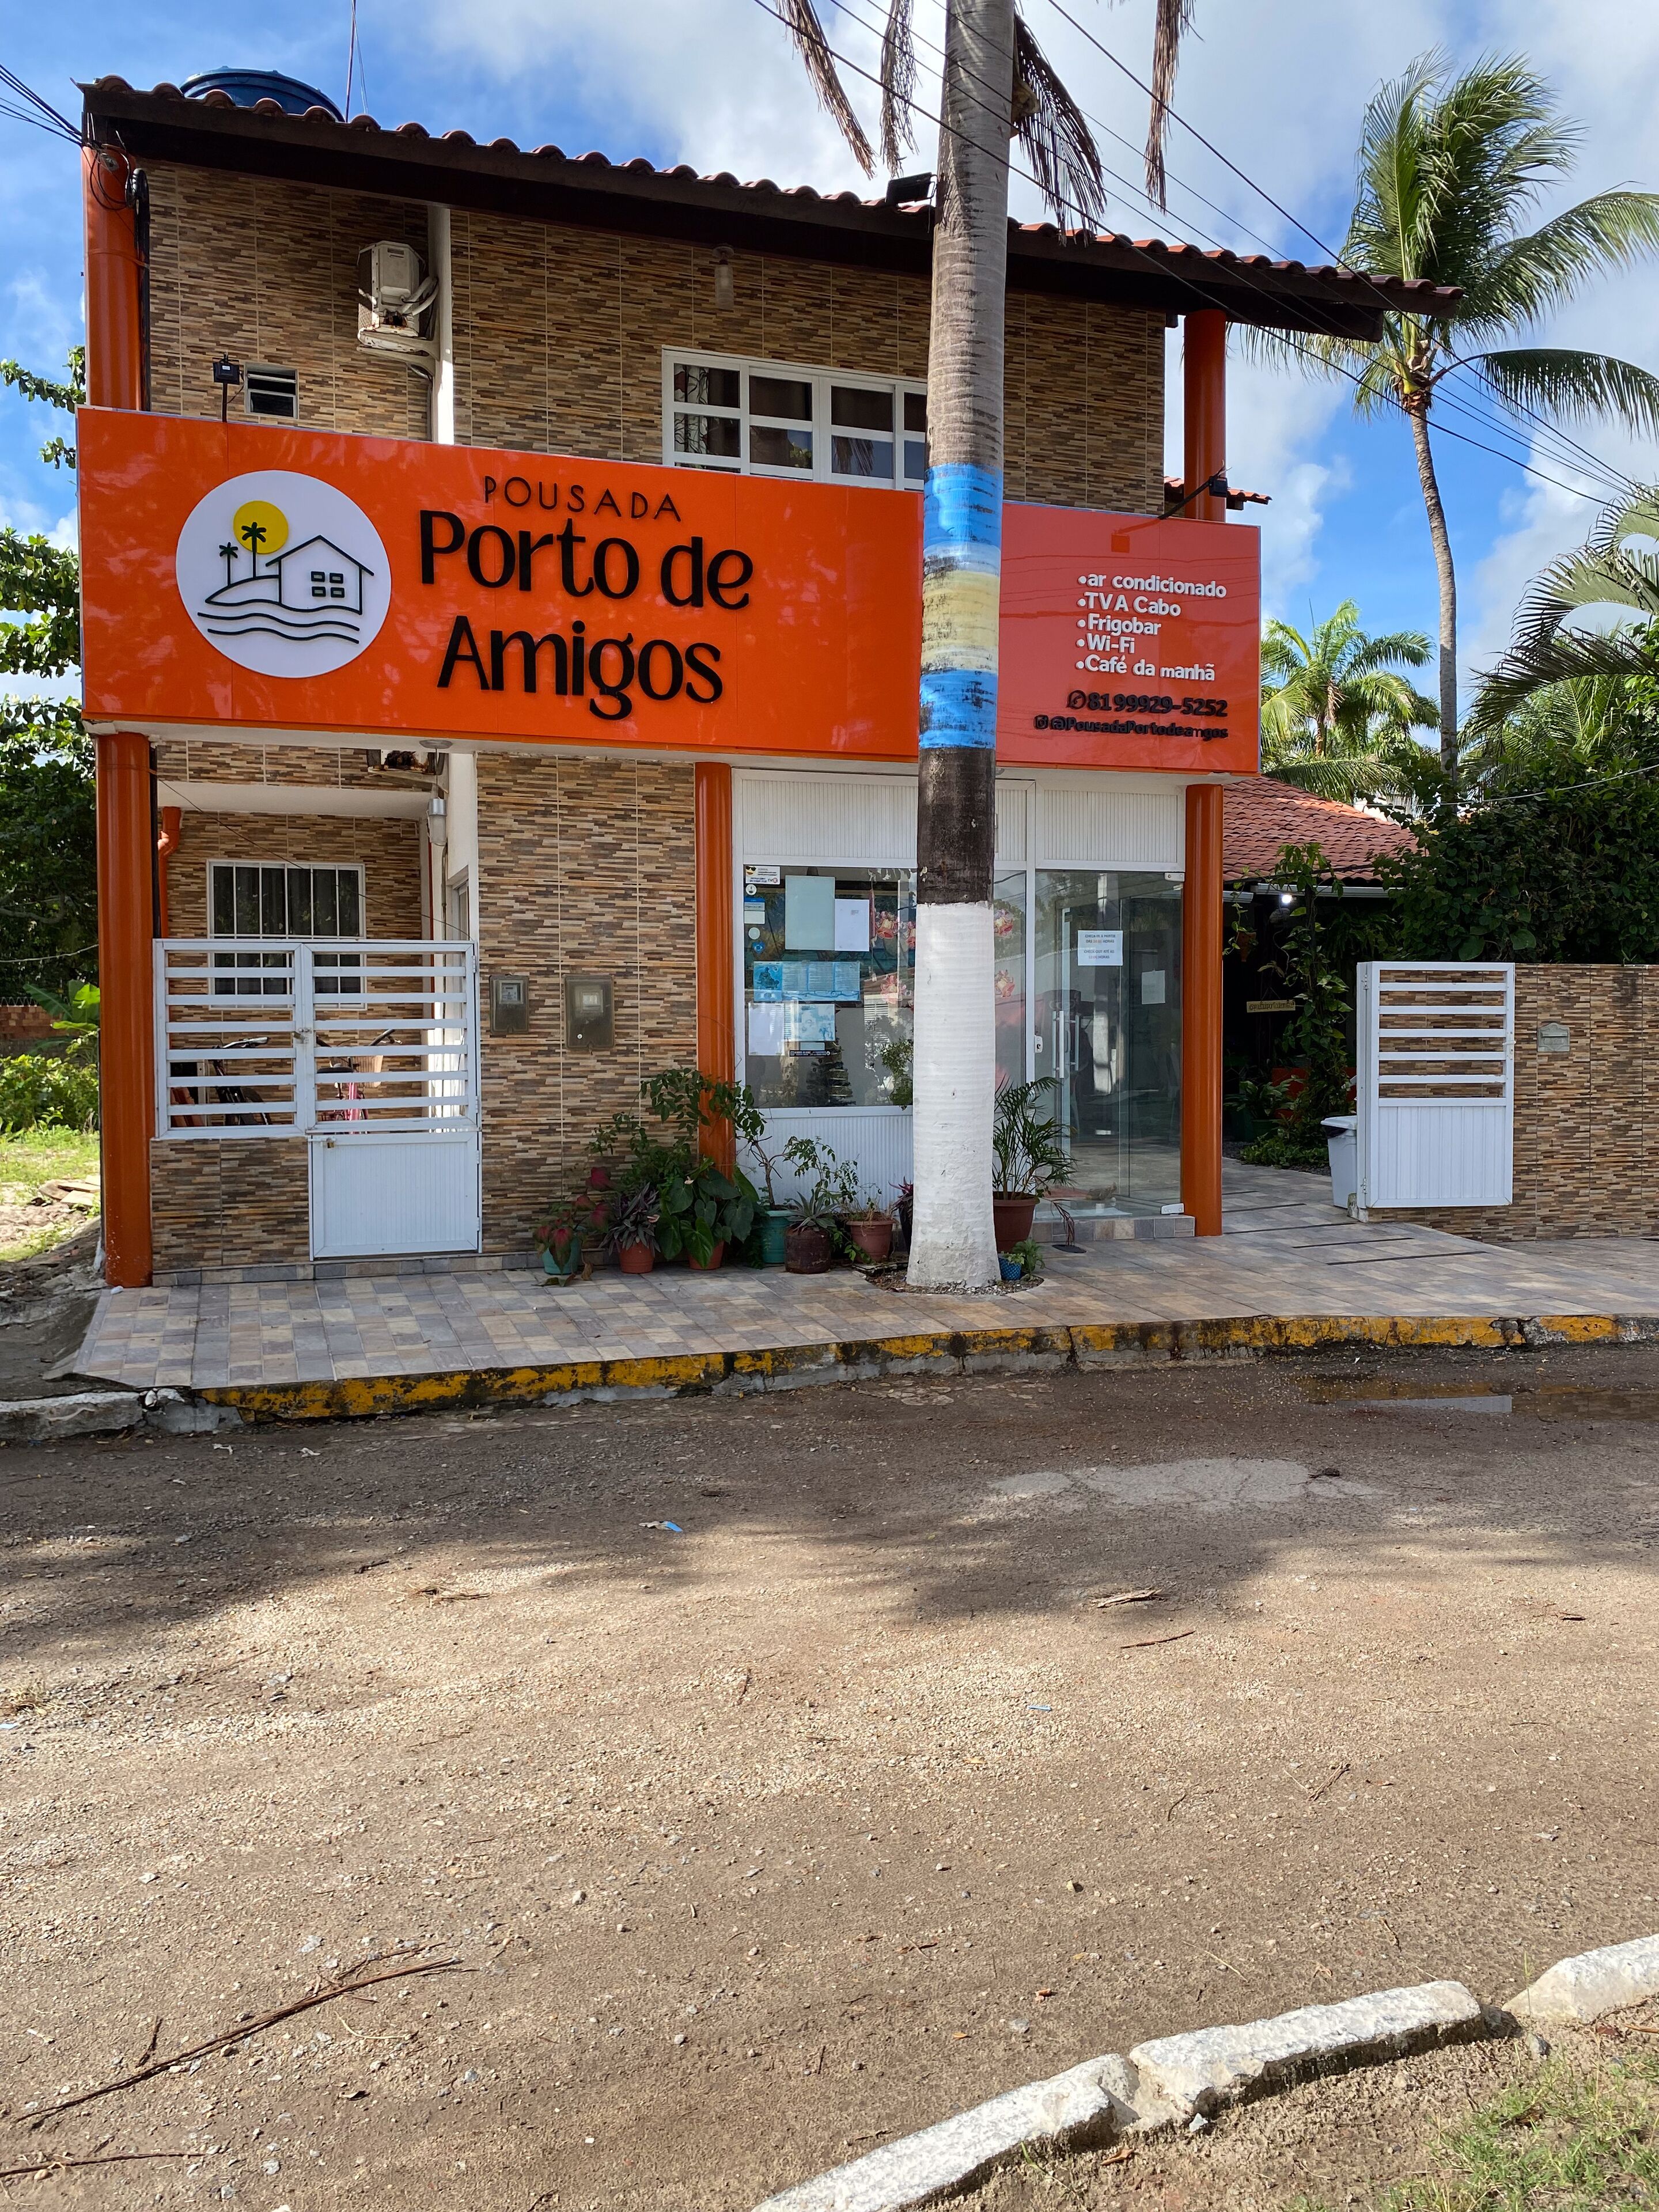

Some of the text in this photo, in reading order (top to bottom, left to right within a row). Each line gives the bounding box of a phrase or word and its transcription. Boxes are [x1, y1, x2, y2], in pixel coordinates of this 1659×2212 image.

[484, 476, 681, 522] POUSADA
[420, 510, 754, 611] Porto de
[1087, 573, 1227, 598] ar condicionado
[1133, 596, 1181, 616] Cabo
[1088, 613, 1162, 636] Frigobar
[1086, 632, 1135, 654] Wi-Fi
[437, 615, 723, 721] Amigos
[1085, 654, 1215, 681] Café da manhã
